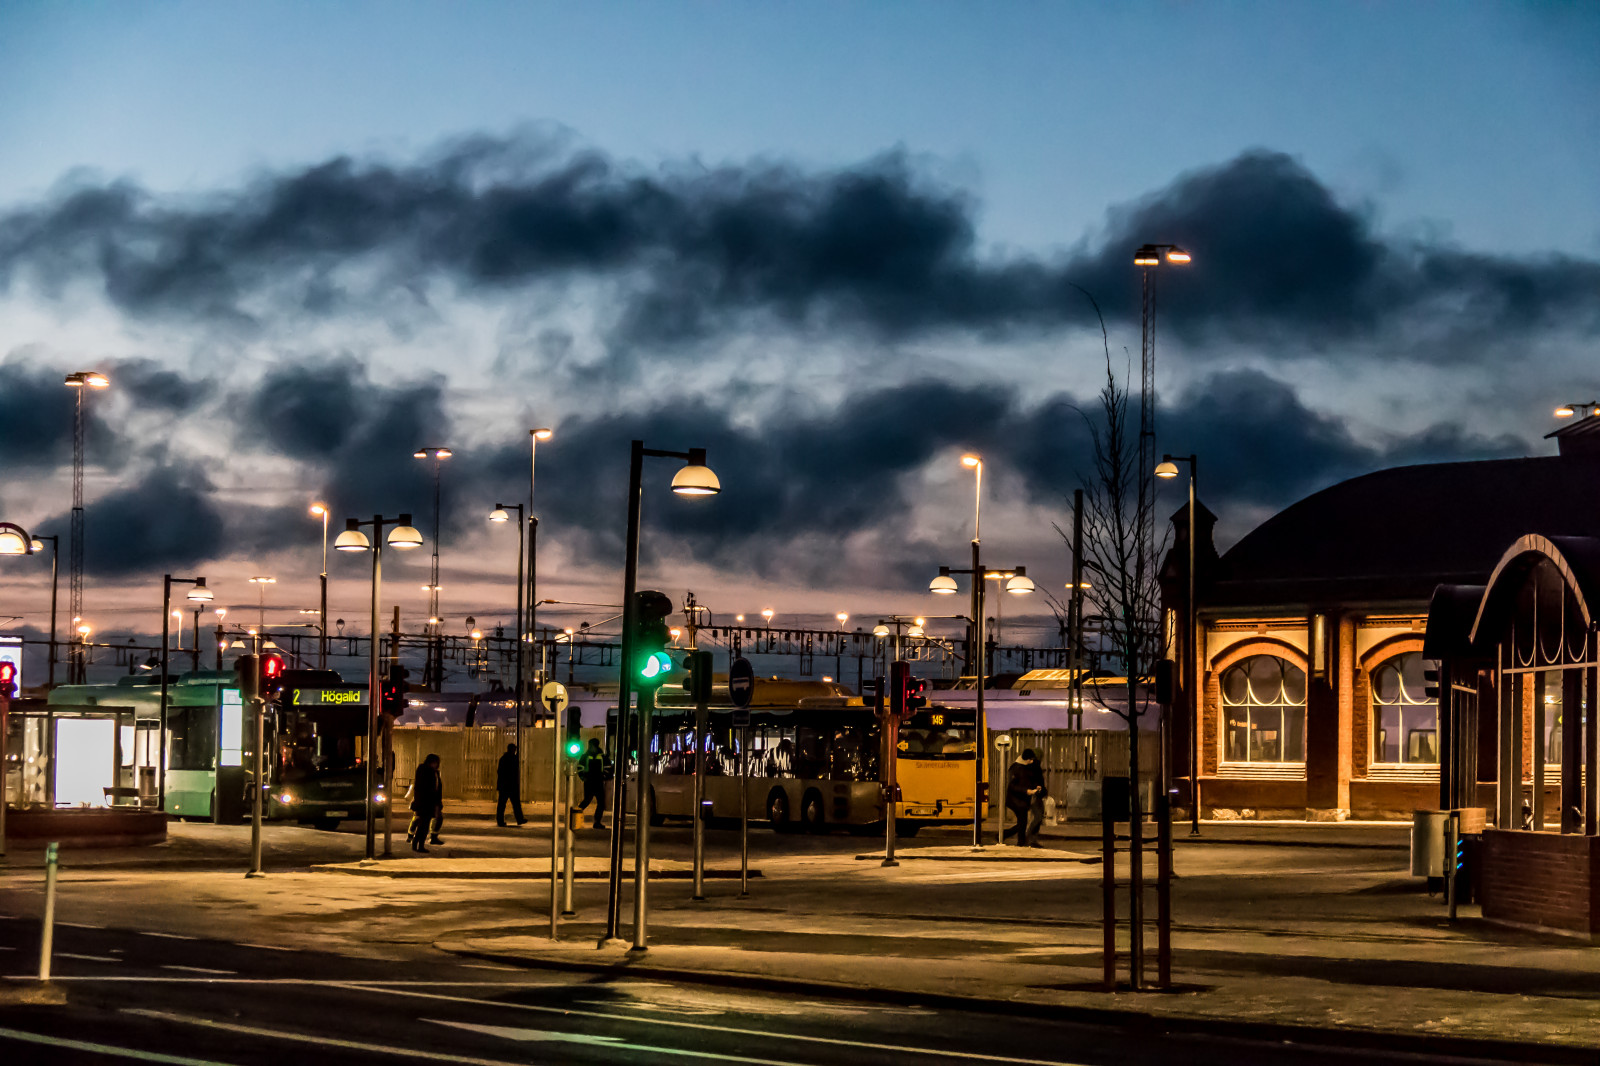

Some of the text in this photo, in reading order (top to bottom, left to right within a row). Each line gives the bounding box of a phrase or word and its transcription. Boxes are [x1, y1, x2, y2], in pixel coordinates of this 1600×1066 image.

[293, 689, 361, 705] 2 Högalid
[932, 714, 943, 725] 146
